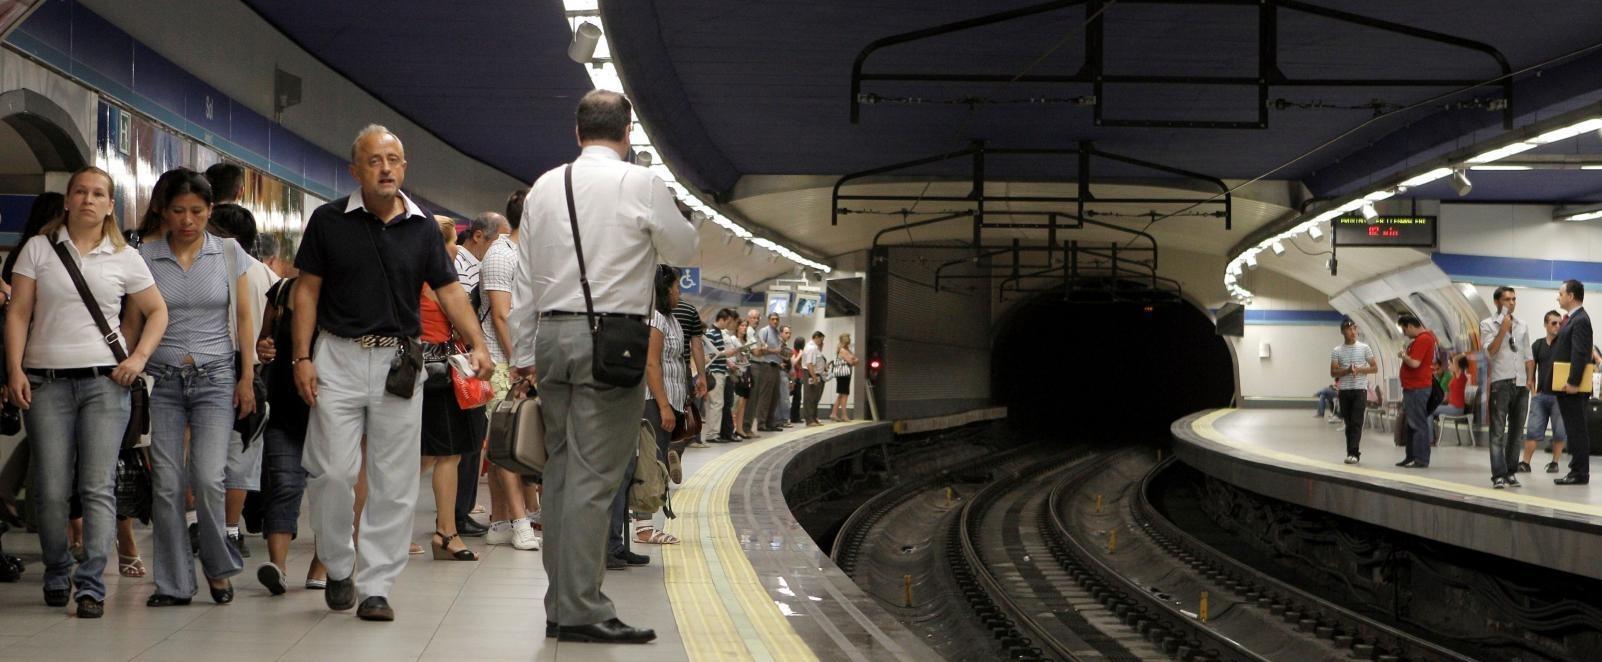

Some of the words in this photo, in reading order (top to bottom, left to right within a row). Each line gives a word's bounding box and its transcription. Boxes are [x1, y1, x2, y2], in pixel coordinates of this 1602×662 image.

[206, 95, 214, 120] Sol
[1368, 226, 1380, 236] 02
[1382, 226, 1399, 236] min
